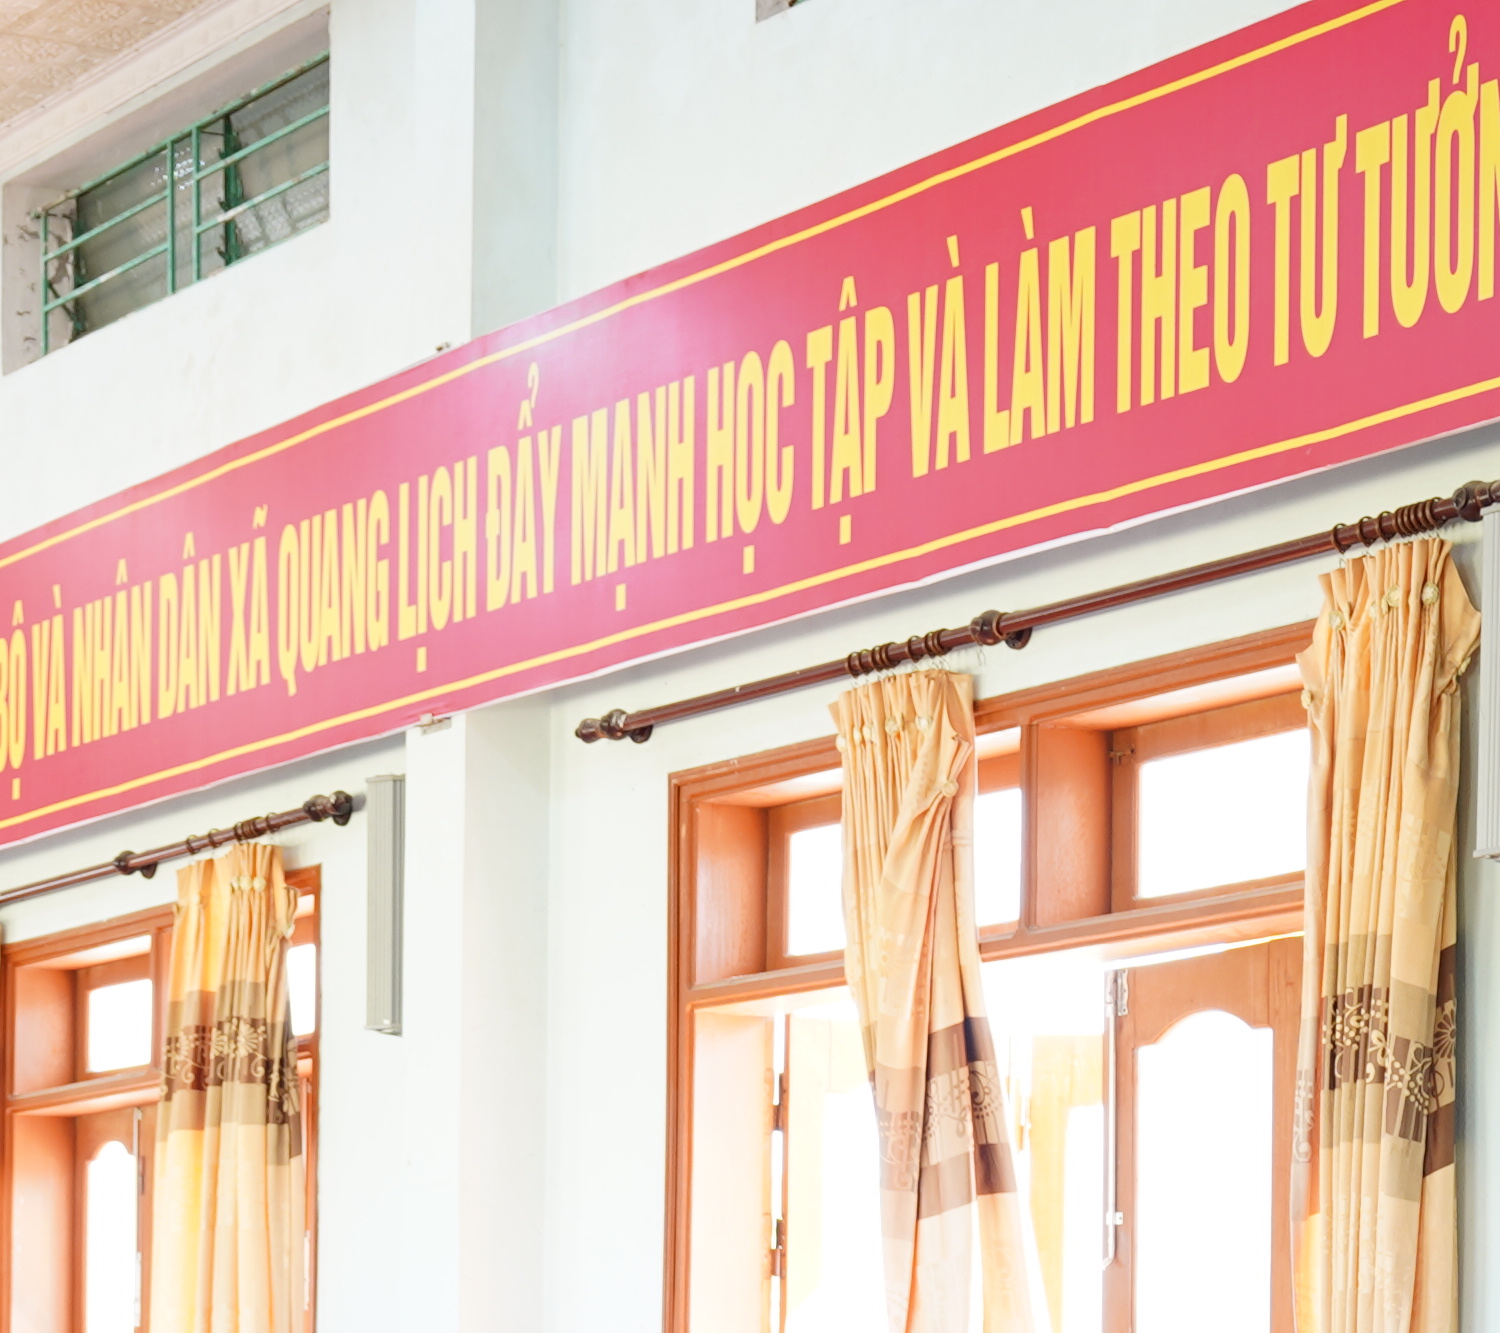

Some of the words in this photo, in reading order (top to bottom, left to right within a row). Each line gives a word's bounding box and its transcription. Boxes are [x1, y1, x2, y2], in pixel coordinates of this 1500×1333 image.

[31, 584, 68, 760] VÀ
[71, 559, 152, 748] NHÂN
[157, 532, 222, 719] DÂN
[226, 506, 271, 696] XÃ
[277, 490, 390, 696] QUANG
[398, 456, 477, 673] LỊCH
[485, 362, 562, 612] ĐẨY
[571, 374, 695, 610] MẠNH
[706, 340, 795, 574] HỌC
[806, 275, 896, 545] TẬP
[906, 234, 971, 478] VÀ
[983, 206, 1097, 454] LÀM
[1109, 172, 1251, 414] THEO
[1266, 113, 1348, 367] TƯ
